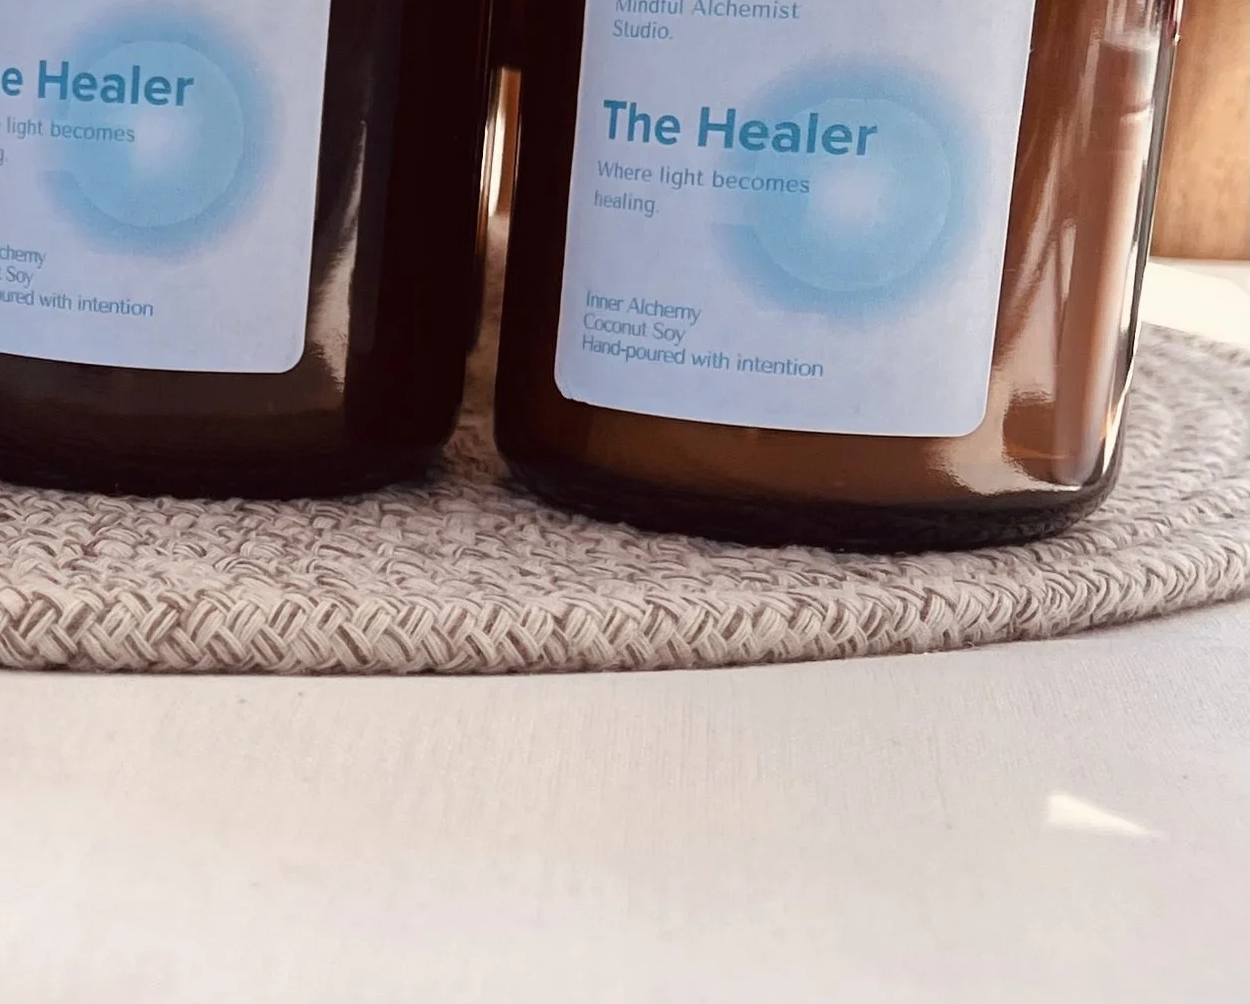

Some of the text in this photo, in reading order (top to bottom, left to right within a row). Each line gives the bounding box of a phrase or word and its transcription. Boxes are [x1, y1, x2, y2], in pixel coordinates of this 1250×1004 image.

[612, 18, 674, 41] Studio.
[36, 59, 196, 107] Healer
[6, 115, 44, 140] light
[50, 120, 136, 143] becomes
[602, 99, 879, 156] The Healer
[596, 160, 811, 194] Where light becomes
[593, 189, 660, 219] healing.
[5, 265, 34, 289] Soy
[39, 292, 72, 311] with
[77, 294, 154, 317] intention
[585, 291, 702, 327] Inner Alchemy
[582, 312, 687, 347] Coconut Soy
[581, 334, 825, 379] Hand-poured with intention
